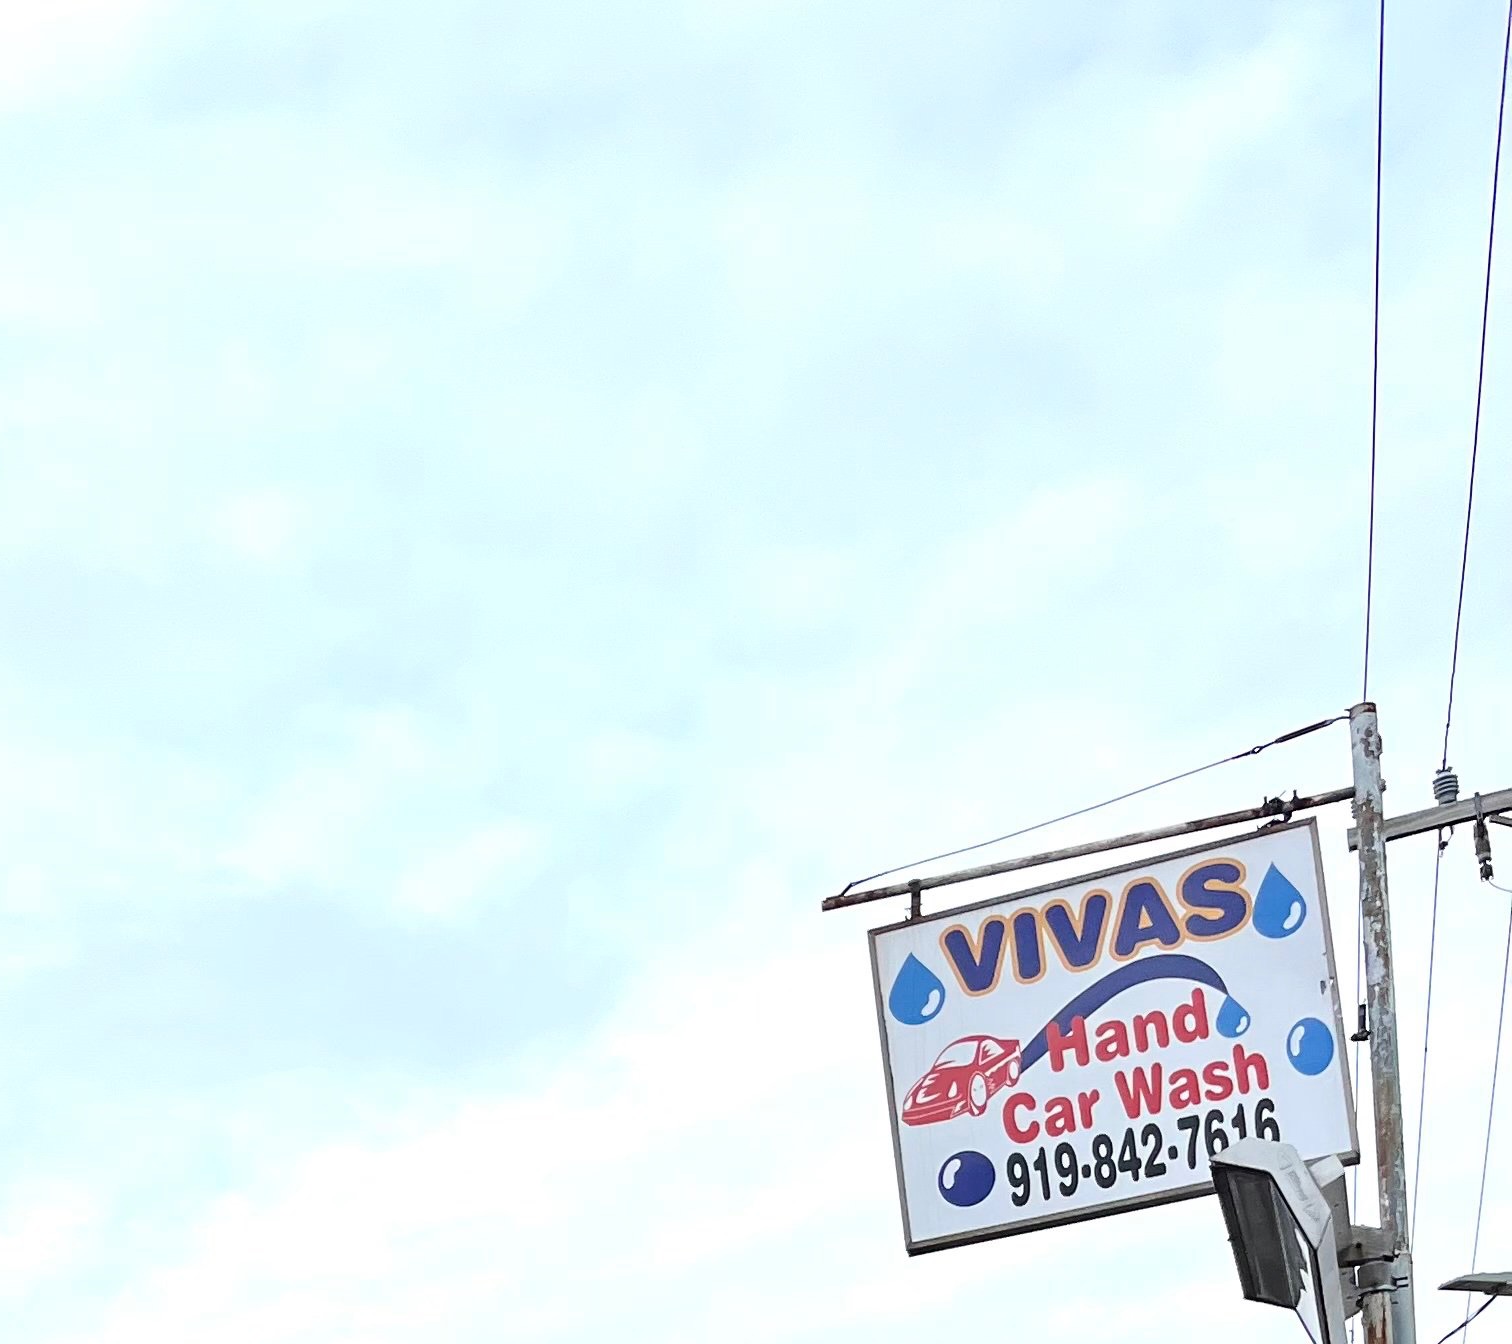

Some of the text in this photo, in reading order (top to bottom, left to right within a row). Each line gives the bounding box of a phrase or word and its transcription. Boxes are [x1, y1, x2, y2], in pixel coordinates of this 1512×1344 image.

[941, 860, 1250, 995] VIVAS
[1045, 988, 1210, 1072] Hand
[1002, 1043, 1269, 1143] Car Wash
